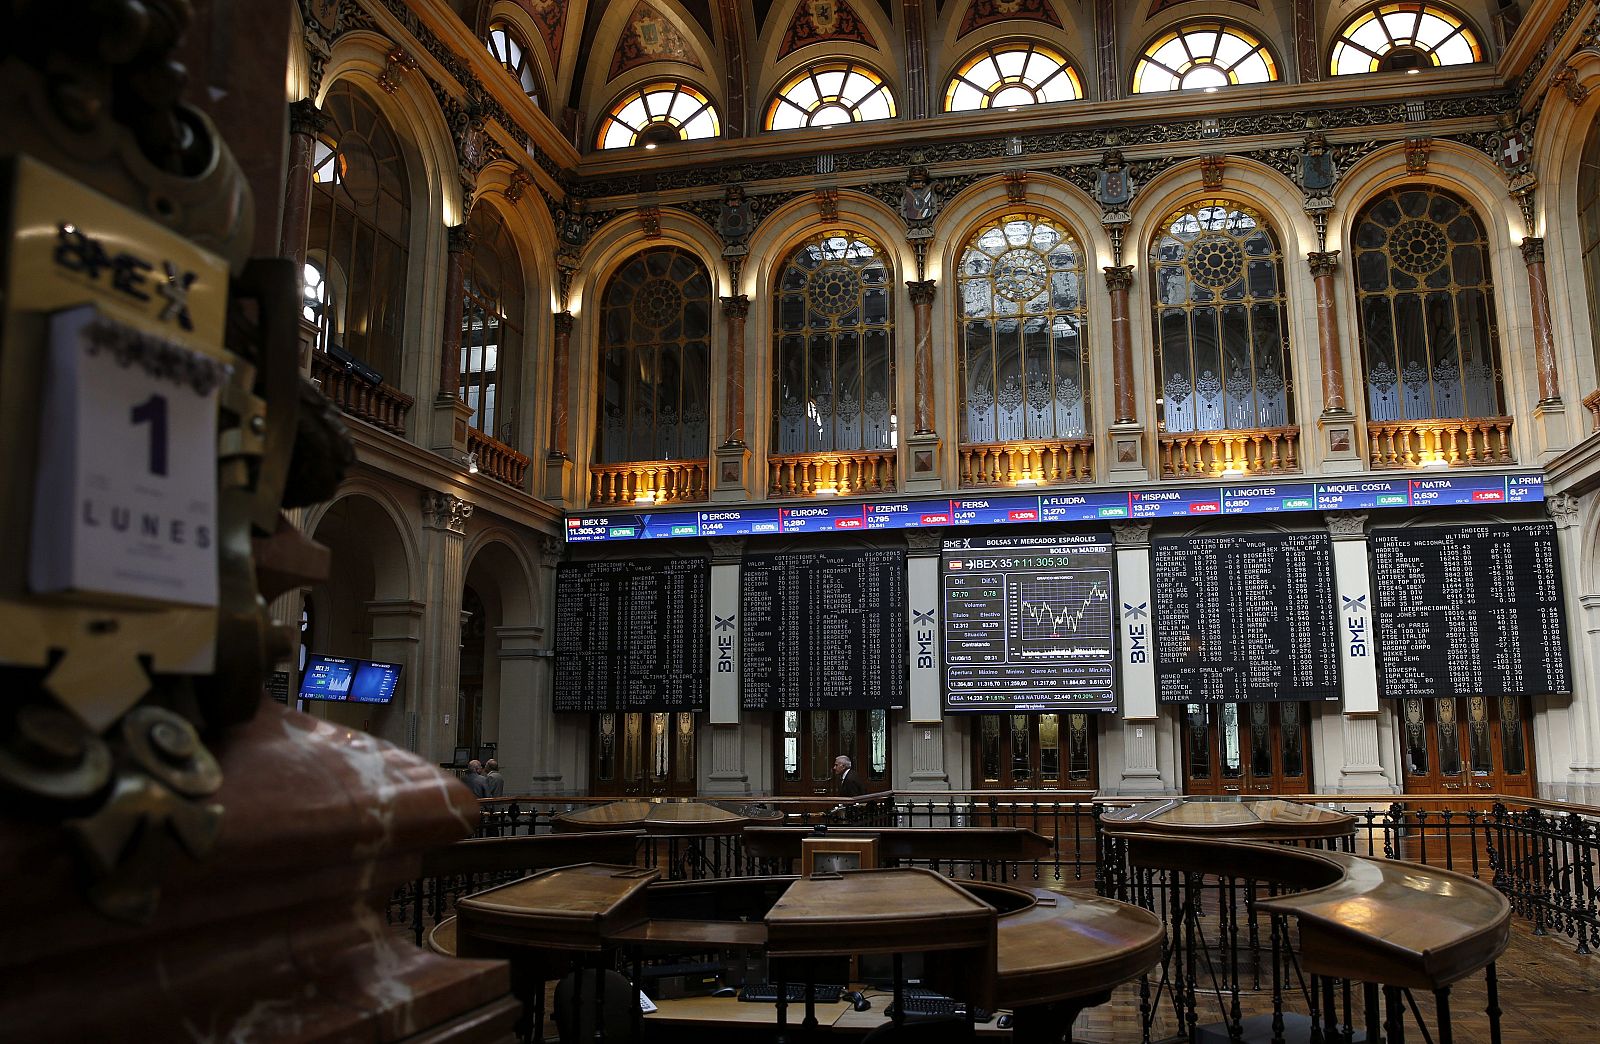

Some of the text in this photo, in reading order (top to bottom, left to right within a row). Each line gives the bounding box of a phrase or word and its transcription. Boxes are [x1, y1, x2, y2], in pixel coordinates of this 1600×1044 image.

[130, 393, 168, 478] 1
[1421, 481, 1452, 489] NATRA
[1518, 477, 1541, 485] PRIM
[1233, 487, 1276, 497] LINGOTES
[1327, 483, 1391, 494] MIQUEL COSTA
[1509, 488, 1529, 496] 8,21
[1050, 496, 1086, 505] FLUIDRA
[1141, 492, 1180, 501] HISPANIA
[1413, 492, 1438, 500] 0,630
[875, 504, 908, 513] EZENTIS
[961, 501, 989, 509] FERSA
[1133, 503, 1160, 512] 13,570
[790, 508, 829, 517] EUROPAC
[954, 511, 976, 519] 0,410
[1043, 507, 1066, 516] 3,270
[709, 512, 741, 521] ERCROS
[82, 500, 211, 549] LUNES
[784, 519, 806, 527] 5,280
[568, 527, 606, 536] 11.305,30
[1020, 537, 1057, 545] MERCADOS
[1058, 535, 1097, 544] ESPAÑOLES
[1288, 534, 1329, 542] 01/06/2015
[973, 557, 1069, 569] IBEX 35 11.305,30
